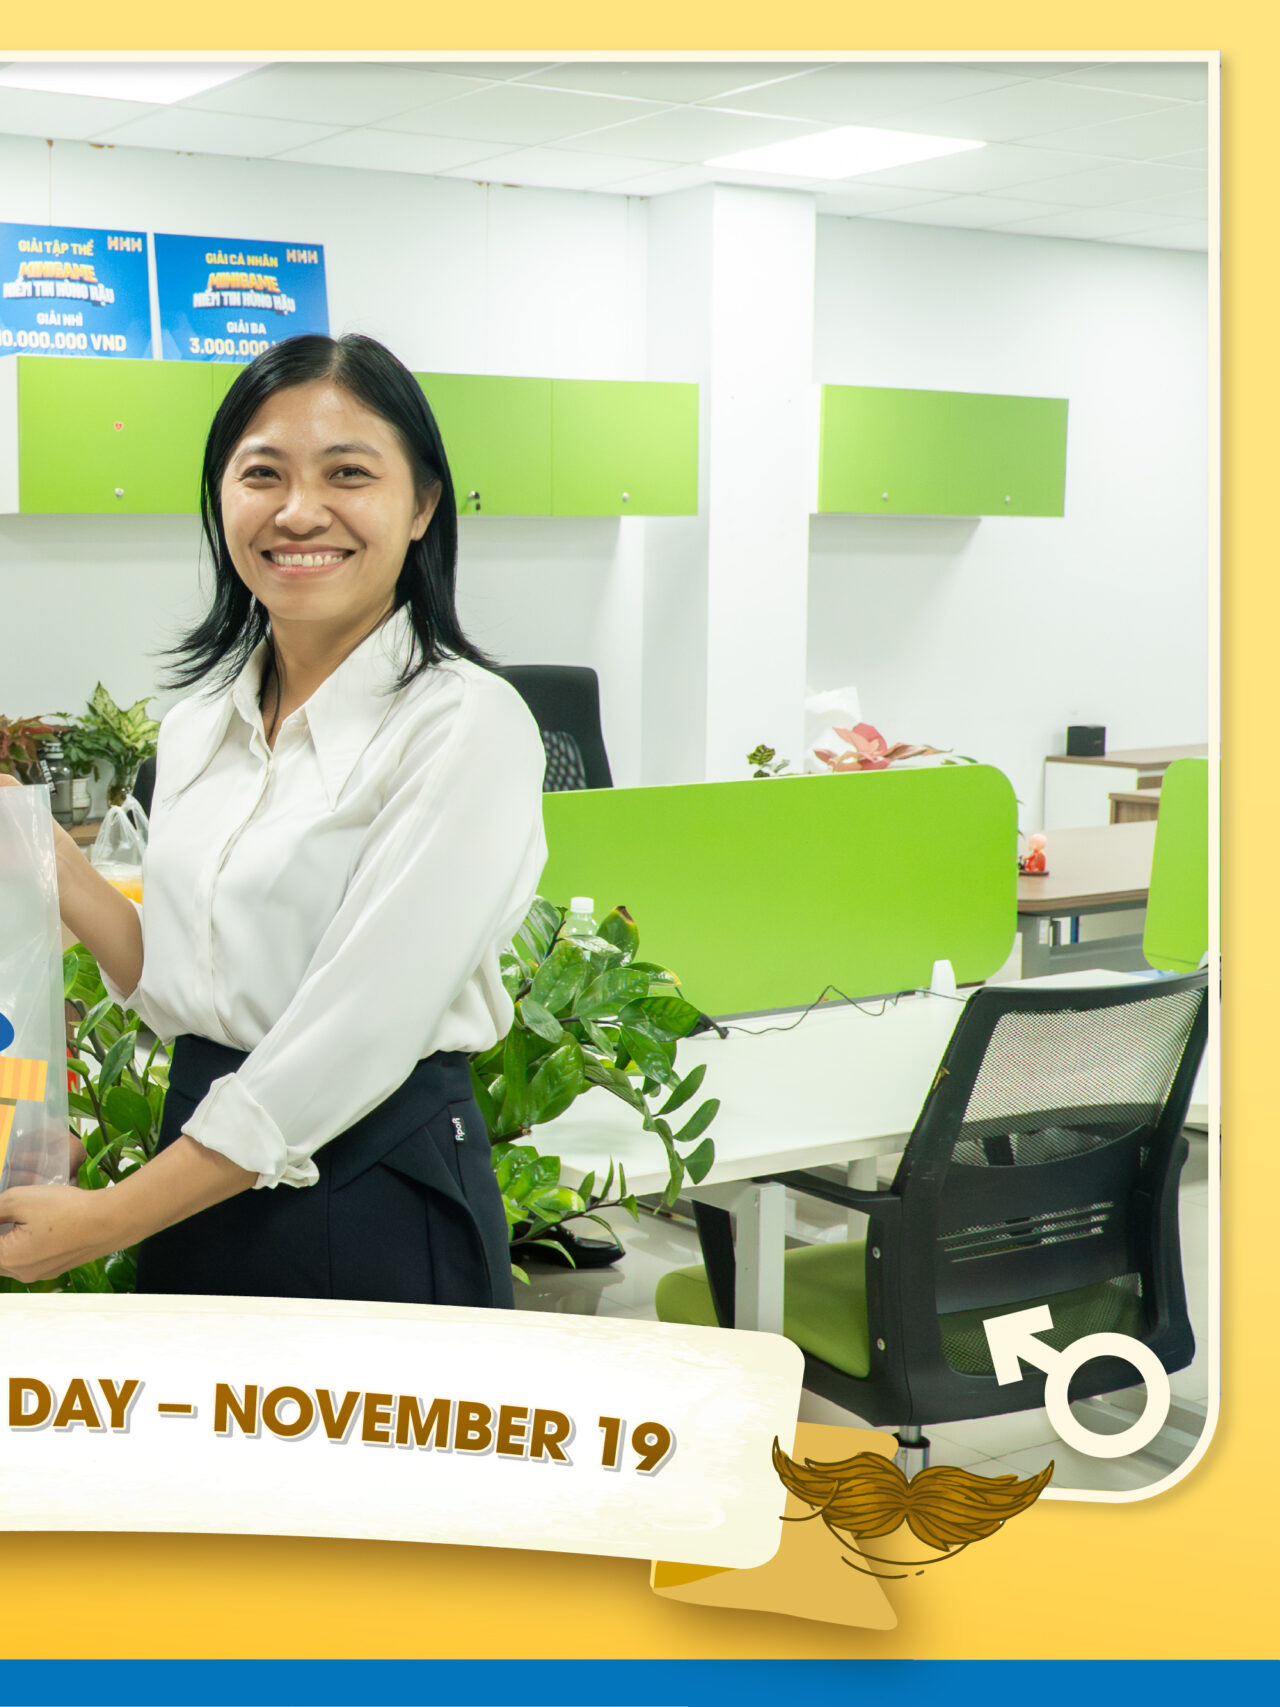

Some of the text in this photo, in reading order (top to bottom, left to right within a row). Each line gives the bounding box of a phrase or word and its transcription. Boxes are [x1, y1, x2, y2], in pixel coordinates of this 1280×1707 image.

[44, 240, 69, 257] TẬP
[18, 261, 98, 283] MINIGAME
[33, 281, 55, 298] TIN
[207, 272, 281, 293] MINIGAME
[221, 291, 242, 307] TIN
[36, 310, 61, 326] GIẢI
[226, 318, 267, 335] GIẢI BA
[90, 335, 127, 352] VND
[189, 337, 269, 356] 3.000.000
